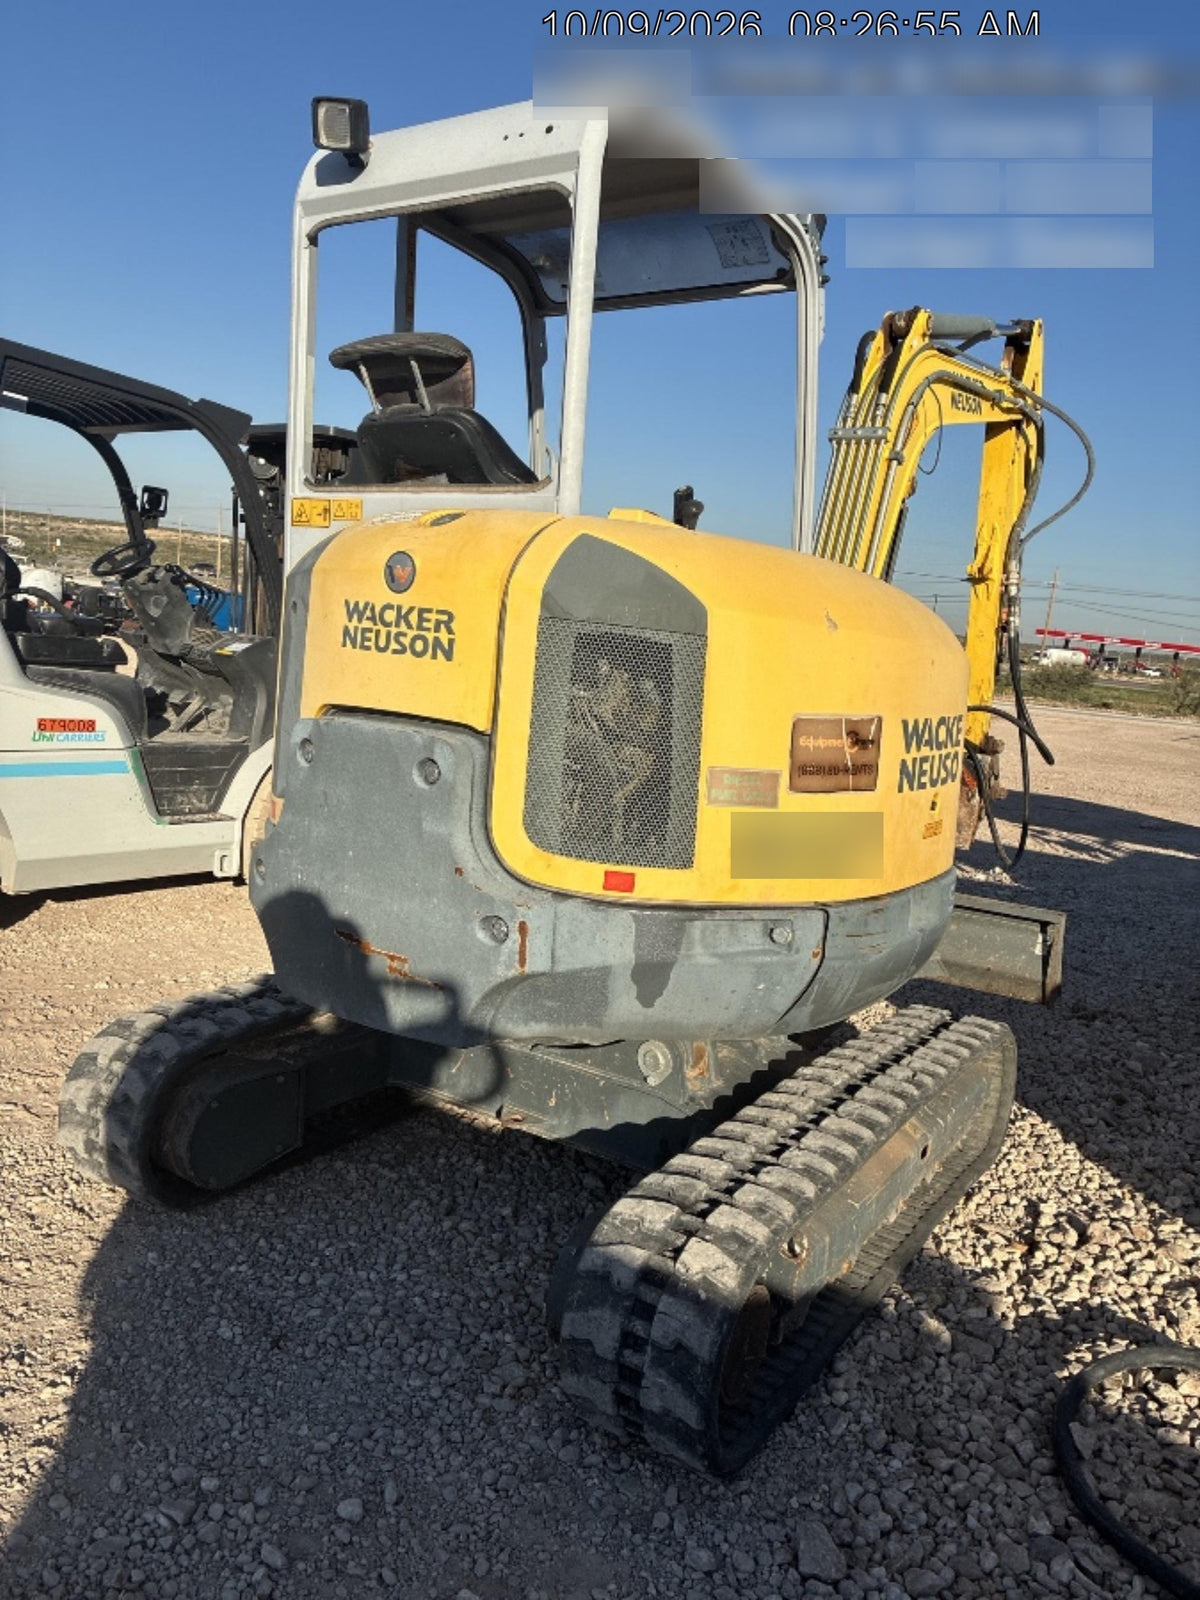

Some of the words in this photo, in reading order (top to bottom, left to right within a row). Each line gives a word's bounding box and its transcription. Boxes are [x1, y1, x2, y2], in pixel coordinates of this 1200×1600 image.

[344, 599, 455, 635] WACKER
[341, 625, 455, 662] NEUSON
[38, 719, 95, 732] 679008
